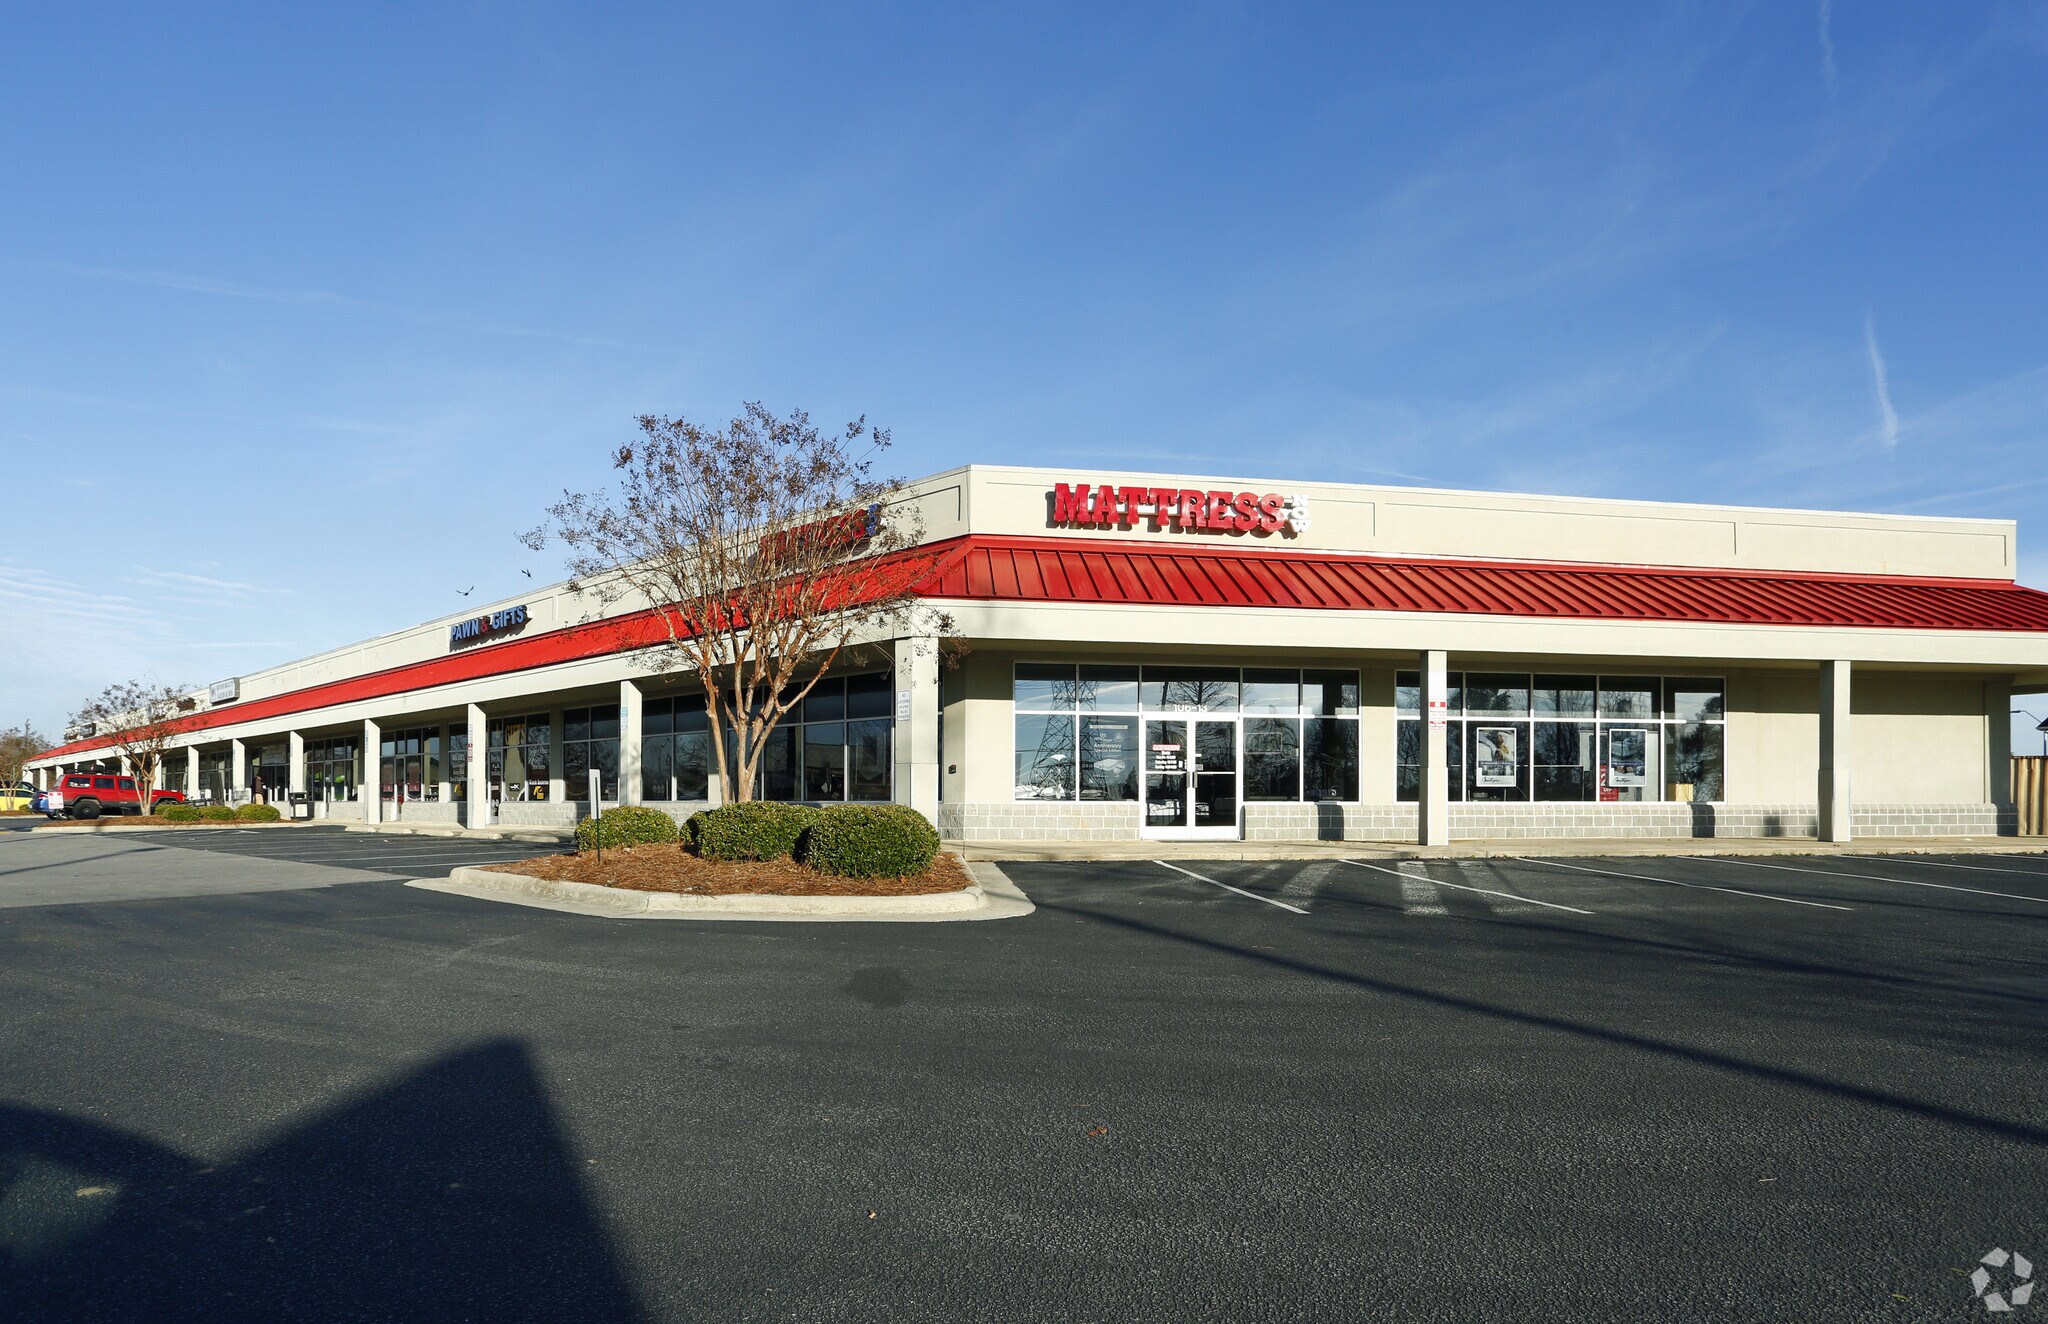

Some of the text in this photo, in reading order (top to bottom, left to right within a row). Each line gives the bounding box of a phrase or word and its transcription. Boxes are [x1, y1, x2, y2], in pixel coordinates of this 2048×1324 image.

[1054, 483, 1285, 532] MATTRESS
[1291, 494, 1311, 533] NOW
[451, 605, 526, 641] PAWN & GIFTS
